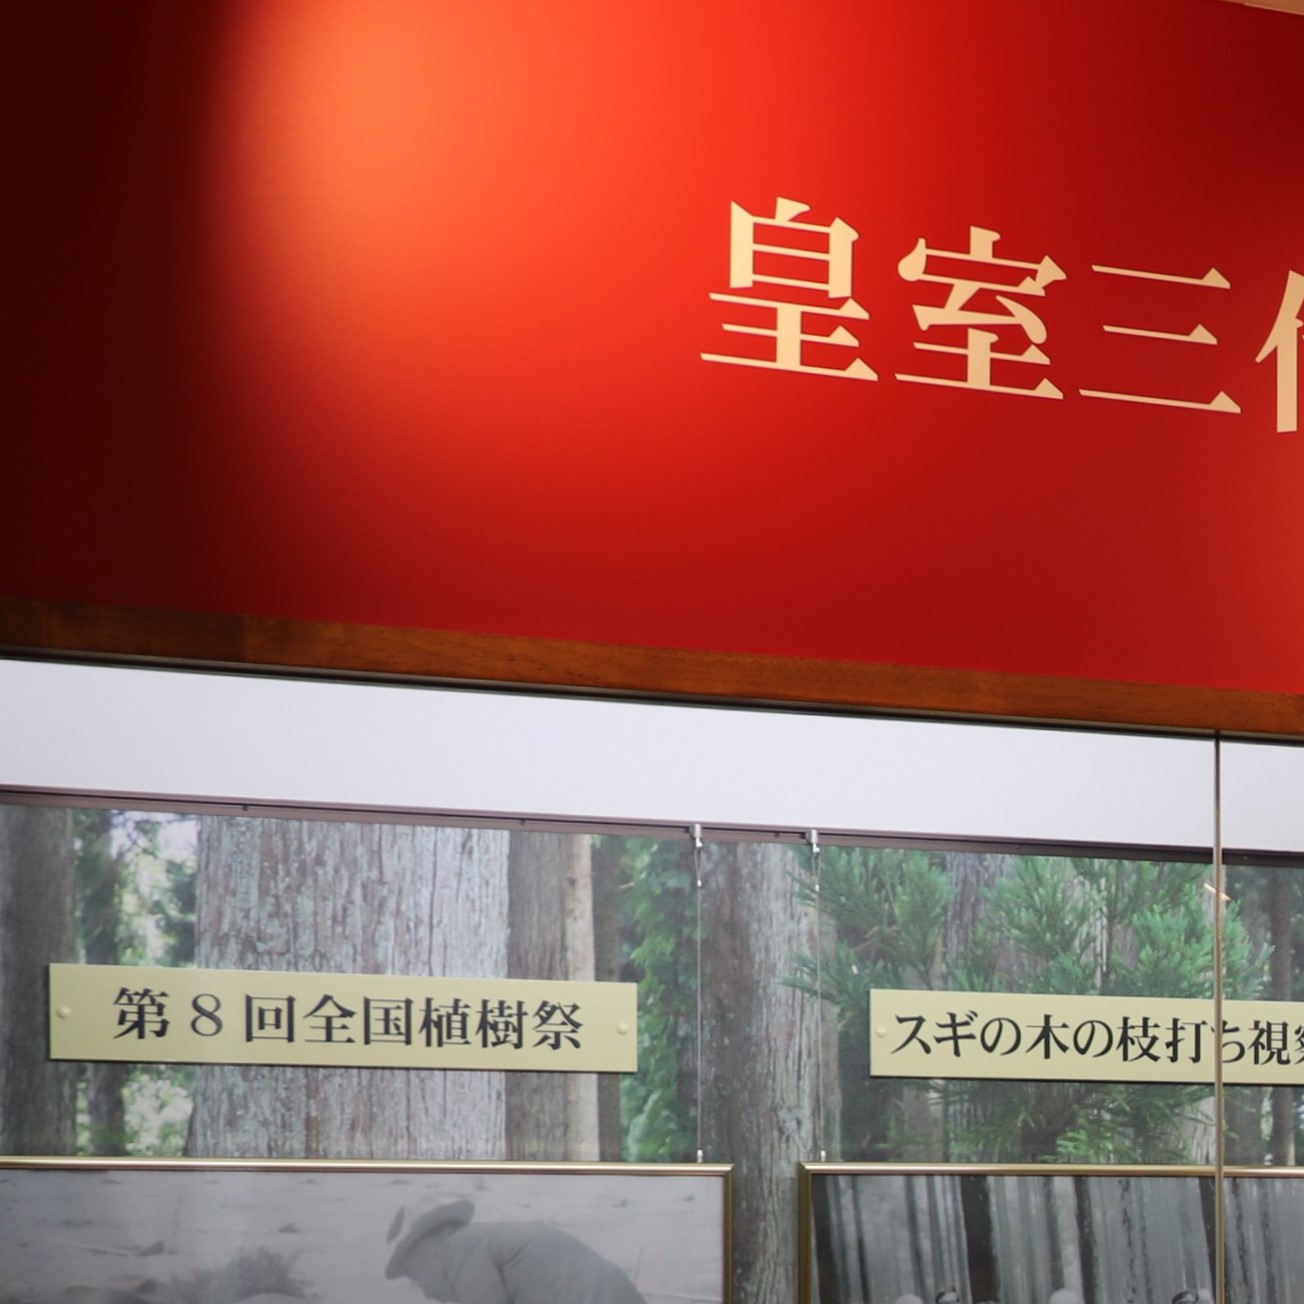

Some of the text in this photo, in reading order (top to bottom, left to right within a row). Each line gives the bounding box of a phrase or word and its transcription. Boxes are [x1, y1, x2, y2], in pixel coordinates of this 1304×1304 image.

[113, 987, 583, 1050] 第8回全国植樹祭
